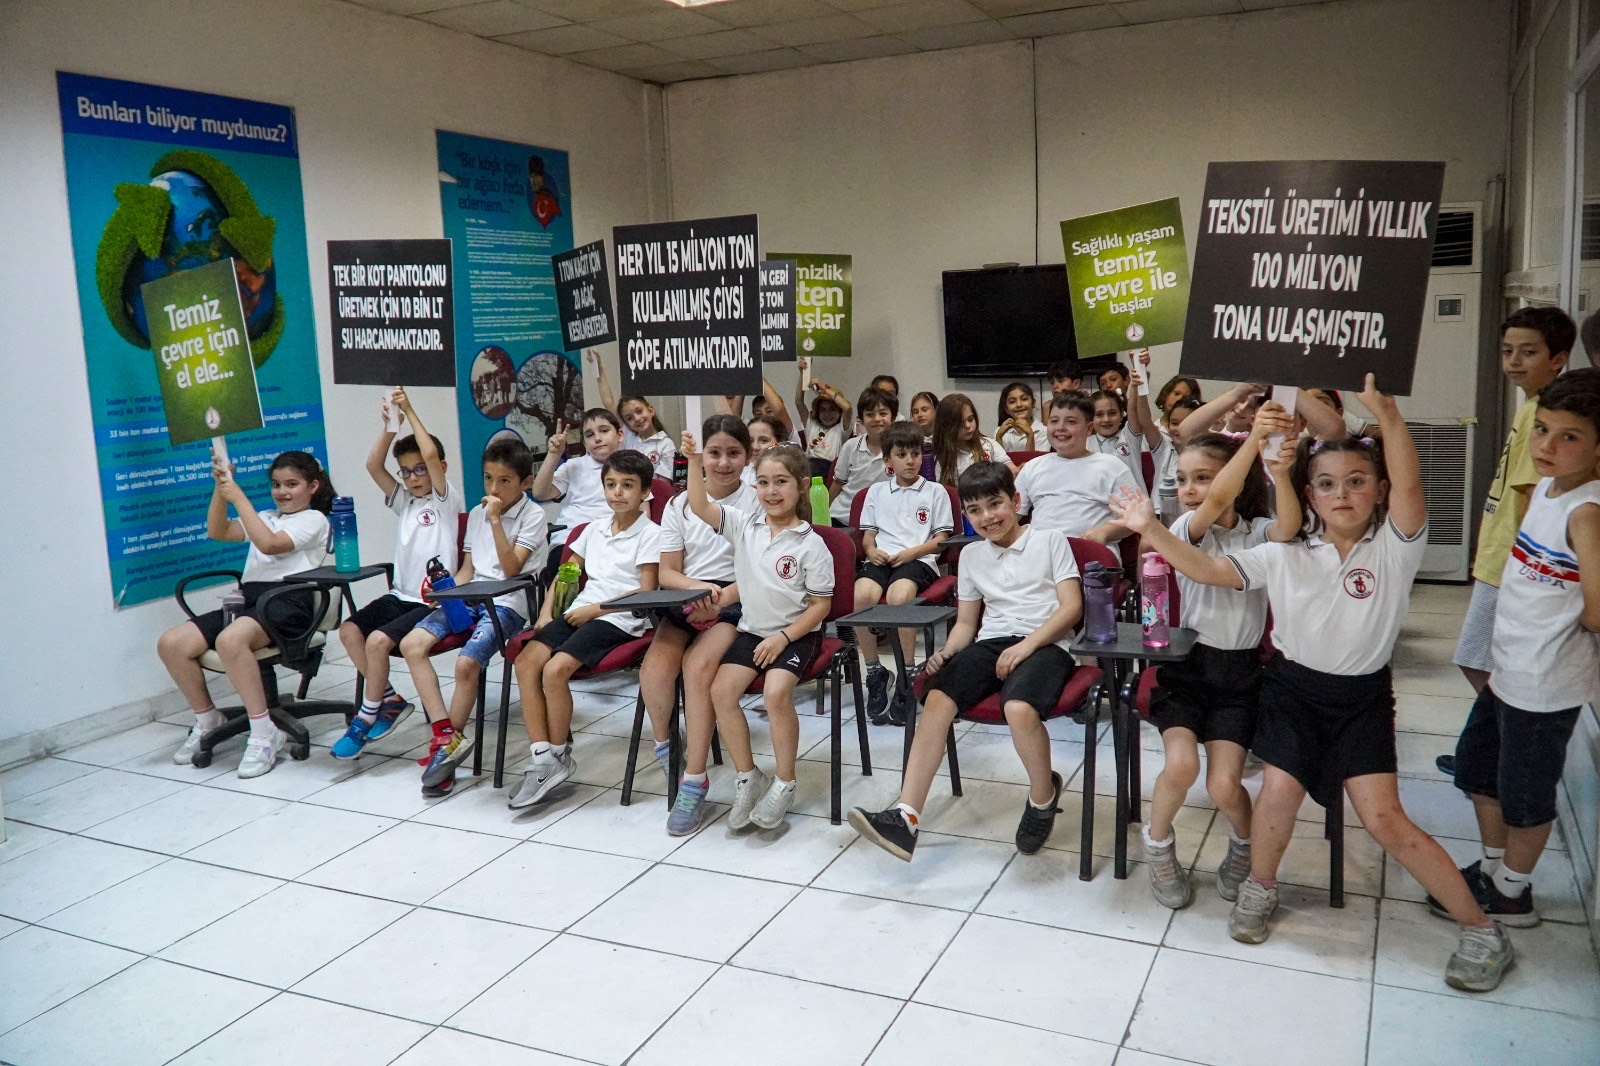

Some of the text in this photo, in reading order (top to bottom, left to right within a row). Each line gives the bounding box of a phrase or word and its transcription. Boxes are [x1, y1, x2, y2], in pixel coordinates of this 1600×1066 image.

[77, 96, 288, 142] Bunları biliyor muydunuz?
[1208, 187, 1432, 238] TEKSTİL ÜRETİMİ YILLIK
[617, 228, 754, 276] HER YIL 15 MİLYON TON
[1072, 225, 1175, 256] Sağlıklı yaşam
[333, 265, 350, 286] TEK
[351, 258, 366, 286] BİR
[367, 265, 386, 286] KOT
[386, 264, 446, 286] PANTOLONU
[562, 258, 574, 282] TON
[769, 264, 788, 286] GERİ
[796, 264, 843, 280] mizlik
[1094, 247, 1158, 277] temiz
[1251, 242, 1362, 292] 100 MİLYON
[632, 274, 744, 330] KULLANILMIŞ GİYSİ
[766, 291, 784, 308] TON
[796, 280, 844, 307] ten
[1084, 268, 1178, 308] çevre ile
[164, 294, 222, 332] Temiz
[338, 291, 380, 318] ÜRETMEK
[380, 290, 400, 325] İÇİN
[400, 297, 412, 318] 10
[413, 290, 430, 318] BİN
[432, 297, 444, 318] LT
[796, 306, 846, 334] aşlar
[1110, 296, 1154, 314] başlar
[761, 313, 788, 330] LIMINI
[1213, 304, 1387, 358] TONA ULAŞMIŞTIR.
[161, 324, 239, 370] çevre için
[342, 328, 444, 350] SU HARCANMAKTADIR.
[762, 335, 784, 351] ADIR.
[628, 330, 754, 380] ÇÖPE ATILMAKTADIR.
[176, 358, 234, 388] el ele...
[1520, 565, 1566, 590] USPA
